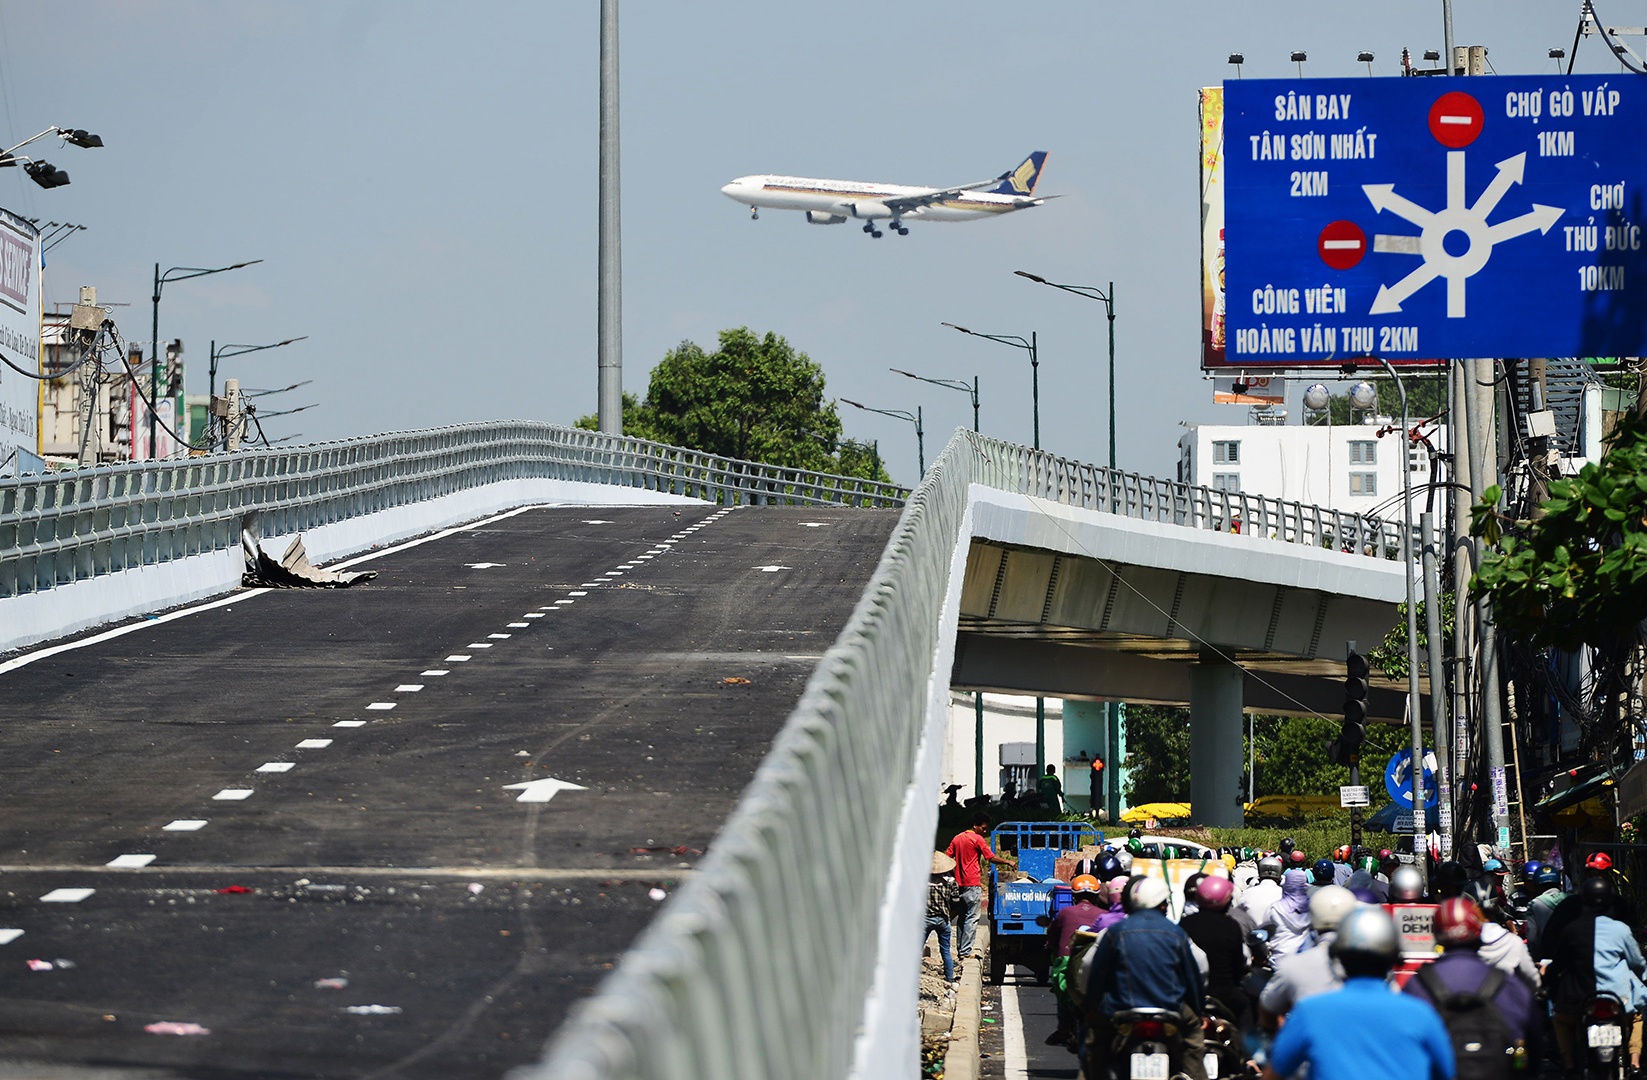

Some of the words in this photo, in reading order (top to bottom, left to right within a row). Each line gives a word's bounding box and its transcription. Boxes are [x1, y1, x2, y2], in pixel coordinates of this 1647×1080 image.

[1275, 91, 1311, 121] SÂN
[1314, 95, 1351, 119] BAY
[1506, 88, 1542, 124] CHỢ
[1550, 85, 1574, 117] GÒ
[1582, 83, 1621, 115] VẤP
[1250, 131, 1286, 160] TÂN
[1291, 131, 1325, 160] SƠN
[1331, 126, 1377, 159] NHẤT
[1537, 132, 1575, 157] 1KM
[1290, 172, 1328, 196] 2KM
[1590, 181, 1626, 214] CHỢ
[1564, 216, 1598, 252] THỦ
[1604, 217, 1641, 251] ĐỨC
[1578, 265, 1625, 292] 10KM
[1252, 284, 1300, 314] CÔNG
[1305, 284, 1346, 313] VIÊN
[1236, 323, 1296, 353] HOÀNG
[1301, 323, 1336, 353] VĂN
[1342, 327, 1374, 356] THỤ
[1380, 327, 1418, 352] 2KM
[1005, 889, 1021, 904] NHẬN
